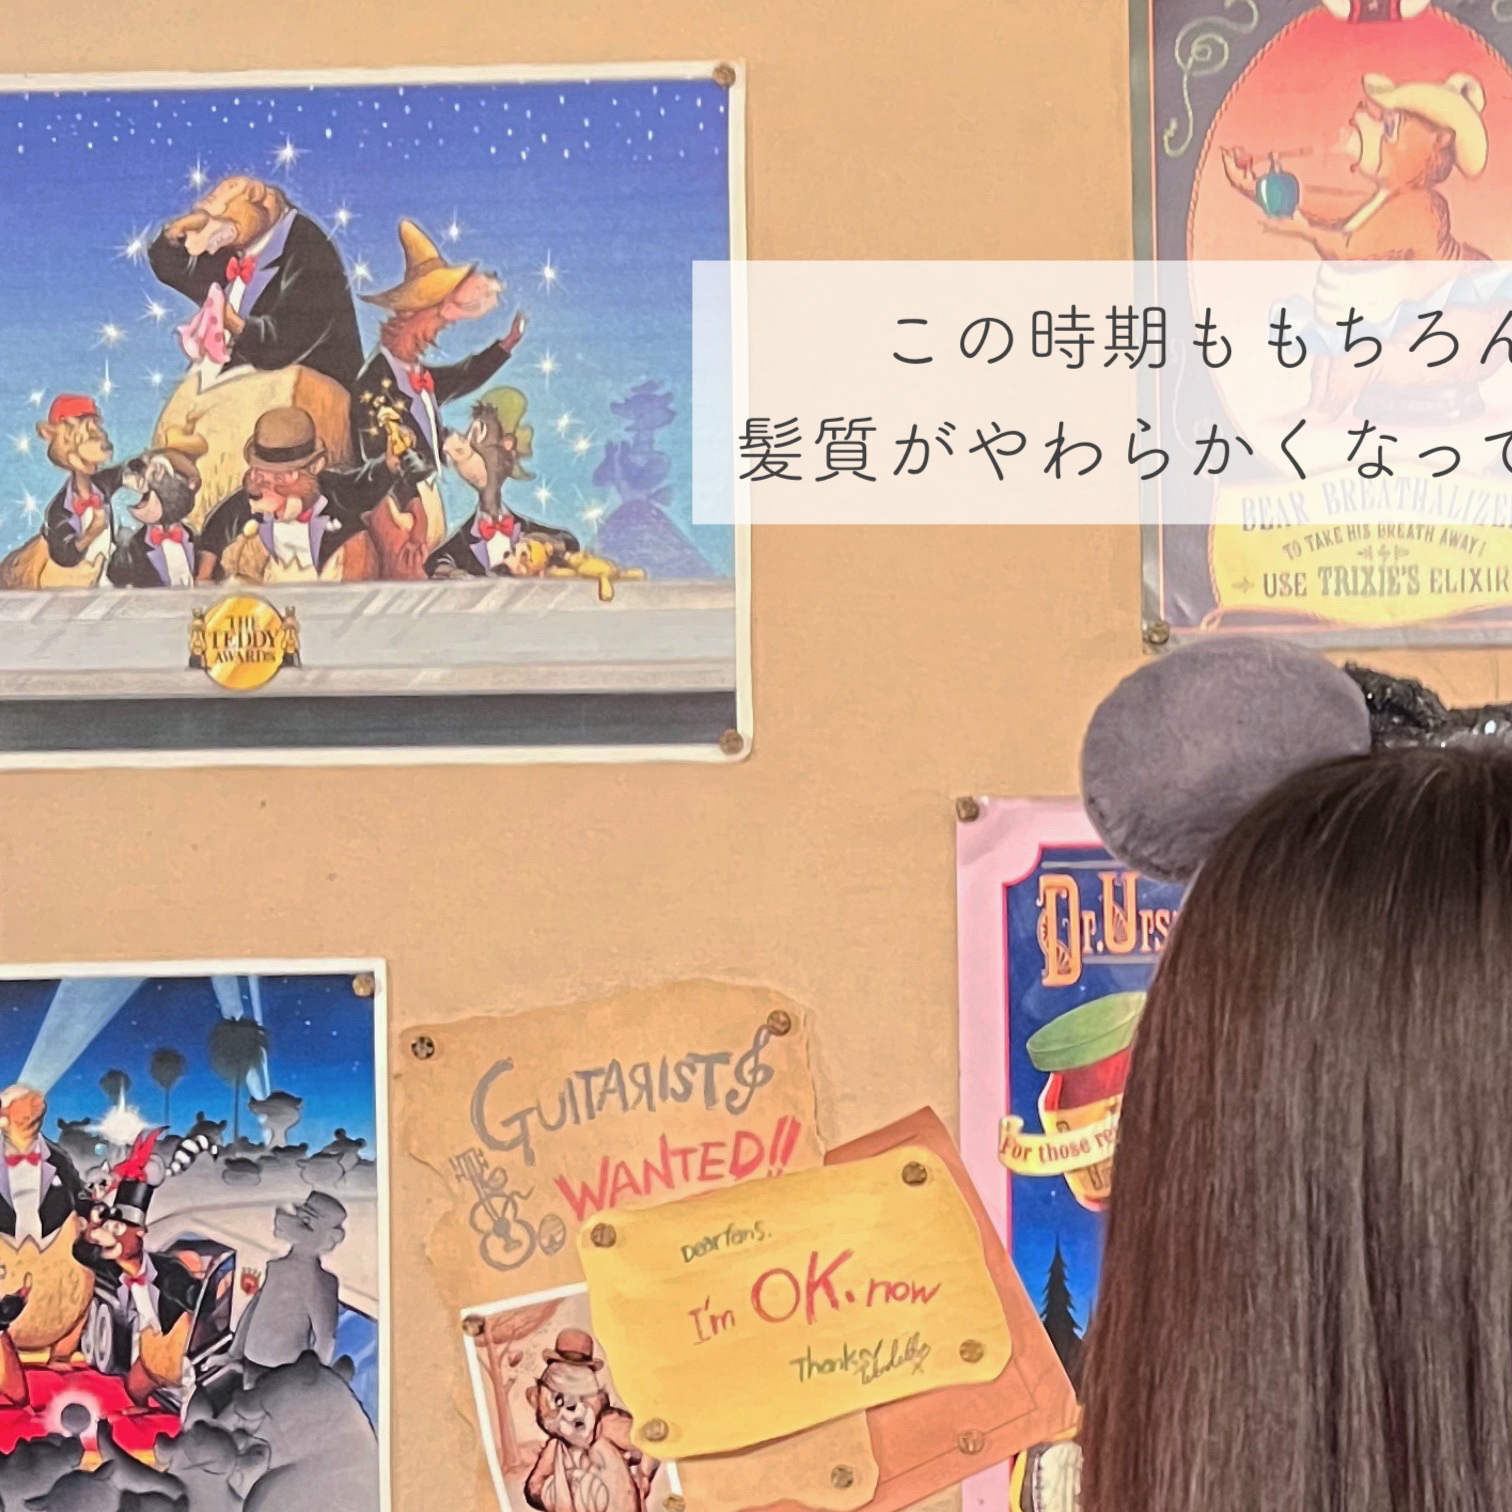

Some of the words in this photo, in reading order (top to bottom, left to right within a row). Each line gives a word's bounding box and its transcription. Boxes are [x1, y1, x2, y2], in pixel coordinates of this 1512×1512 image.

[1240, 489, 1311, 533] BEAR
[1281, 541, 1303, 561] TO
[1304, 525, 1344, 553] TAKE
[1347, 522, 1372, 543] HIS
[1376, 522, 1435, 543] BREATH
[1262, 571, 1308, 599] USE
[1317, 563, 1421, 598] TRIXIE'S
[1429, 565, 1511, 594] ELIXIR
[210, 630, 279, 649] TEDDY
[553, 1115, 802, 1222] WANTED!!
[999, 1135, 1033, 1162] For
[1038, 1137, 1092, 1165] those
[688, 1295, 736, 1346] I'm
[865, 1278, 942, 1308] now
